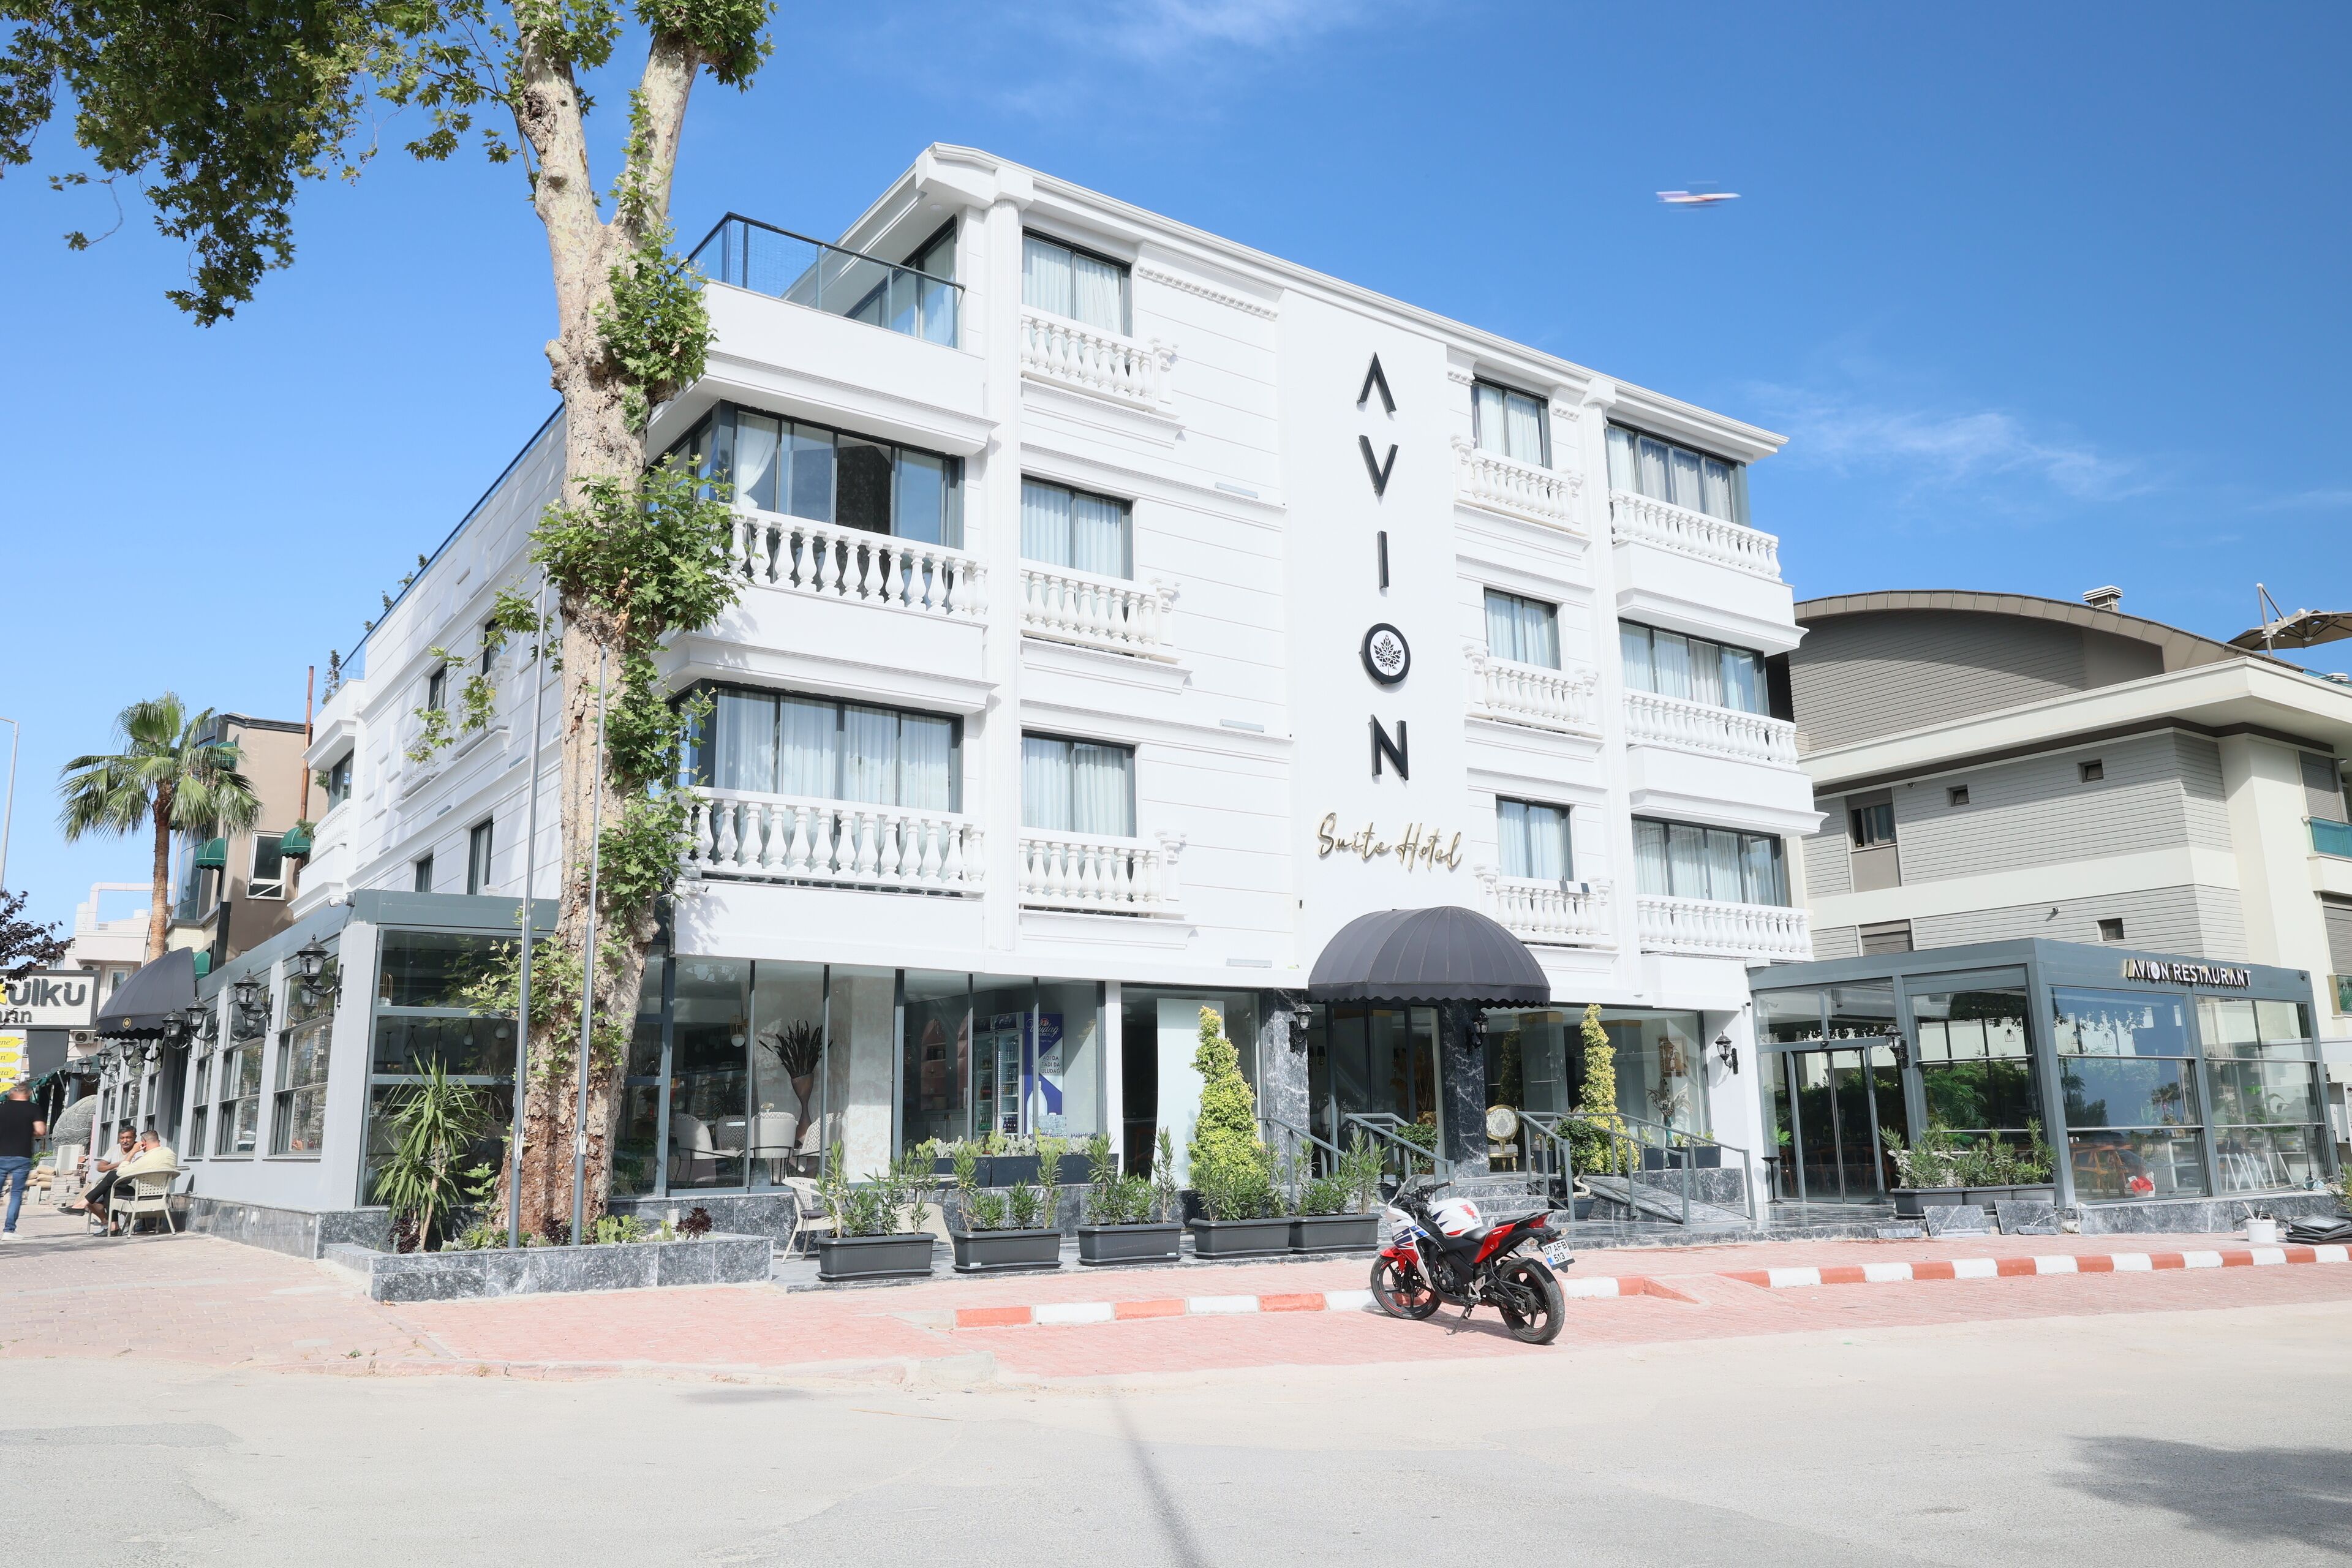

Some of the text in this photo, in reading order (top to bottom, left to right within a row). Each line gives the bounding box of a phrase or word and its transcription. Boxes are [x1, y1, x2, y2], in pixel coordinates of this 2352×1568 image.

[1357, 352, 1411, 782] AVION
[1317, 812, 1463, 870] Suite Hotel
[2132, 960, 2252, 986] AVION RESTAURANT
[1544, 1241, 1567, 1255] 07 AFB
[1553, 1252, 1566, 1262] 513
